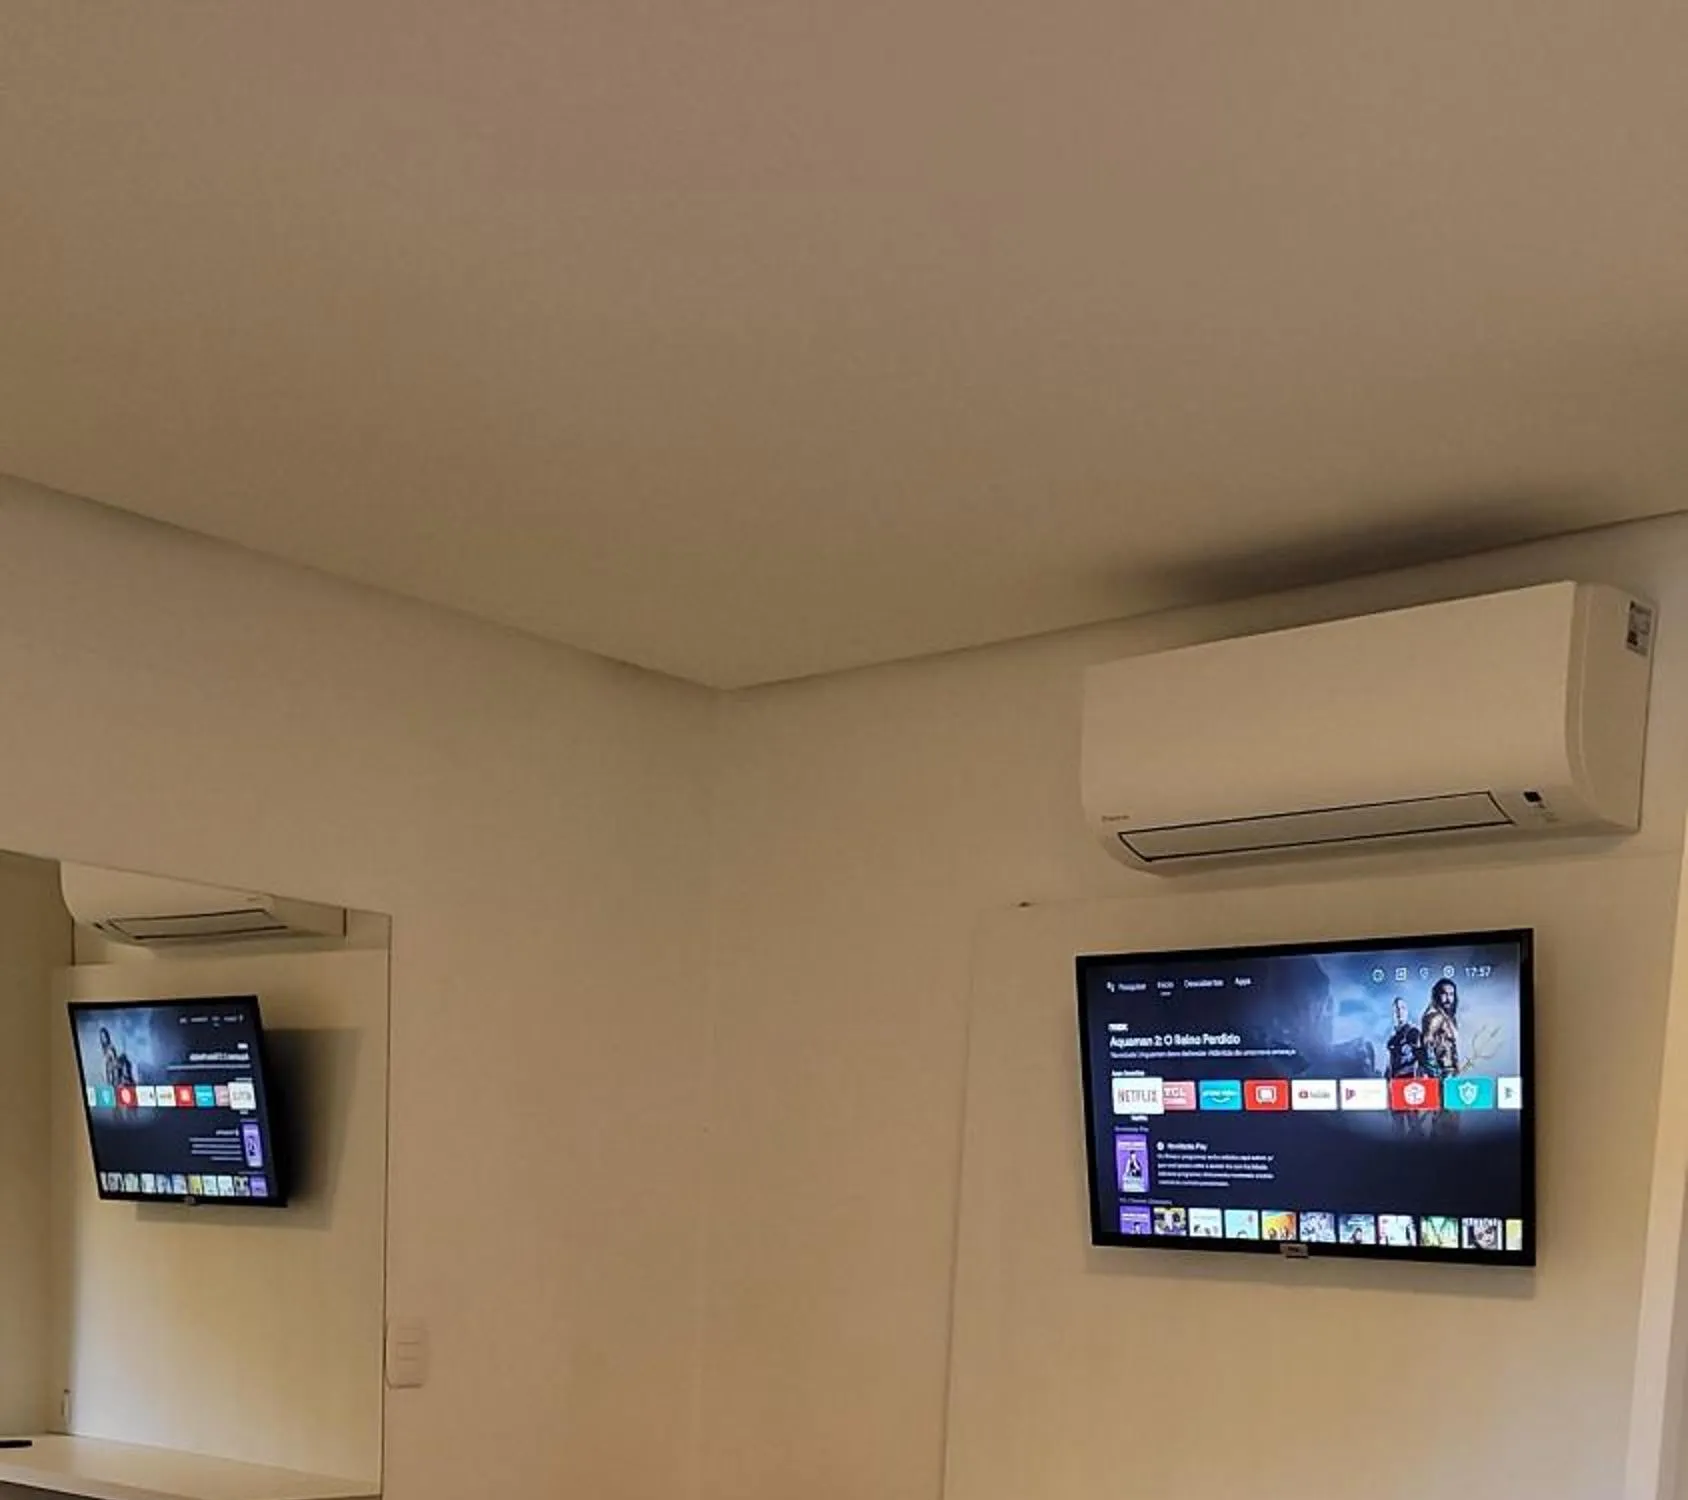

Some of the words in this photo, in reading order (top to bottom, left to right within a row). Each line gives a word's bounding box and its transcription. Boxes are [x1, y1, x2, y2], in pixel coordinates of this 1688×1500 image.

[1109, 1035, 1152, 1048] Aquaman
[1164, 1034, 1172, 1045] O
[1174, 1034, 1200, 1046] Reino
[1202, 1033, 1241, 1045] Perdido
[1117, 1089, 1159, 1104] NETFLIX
